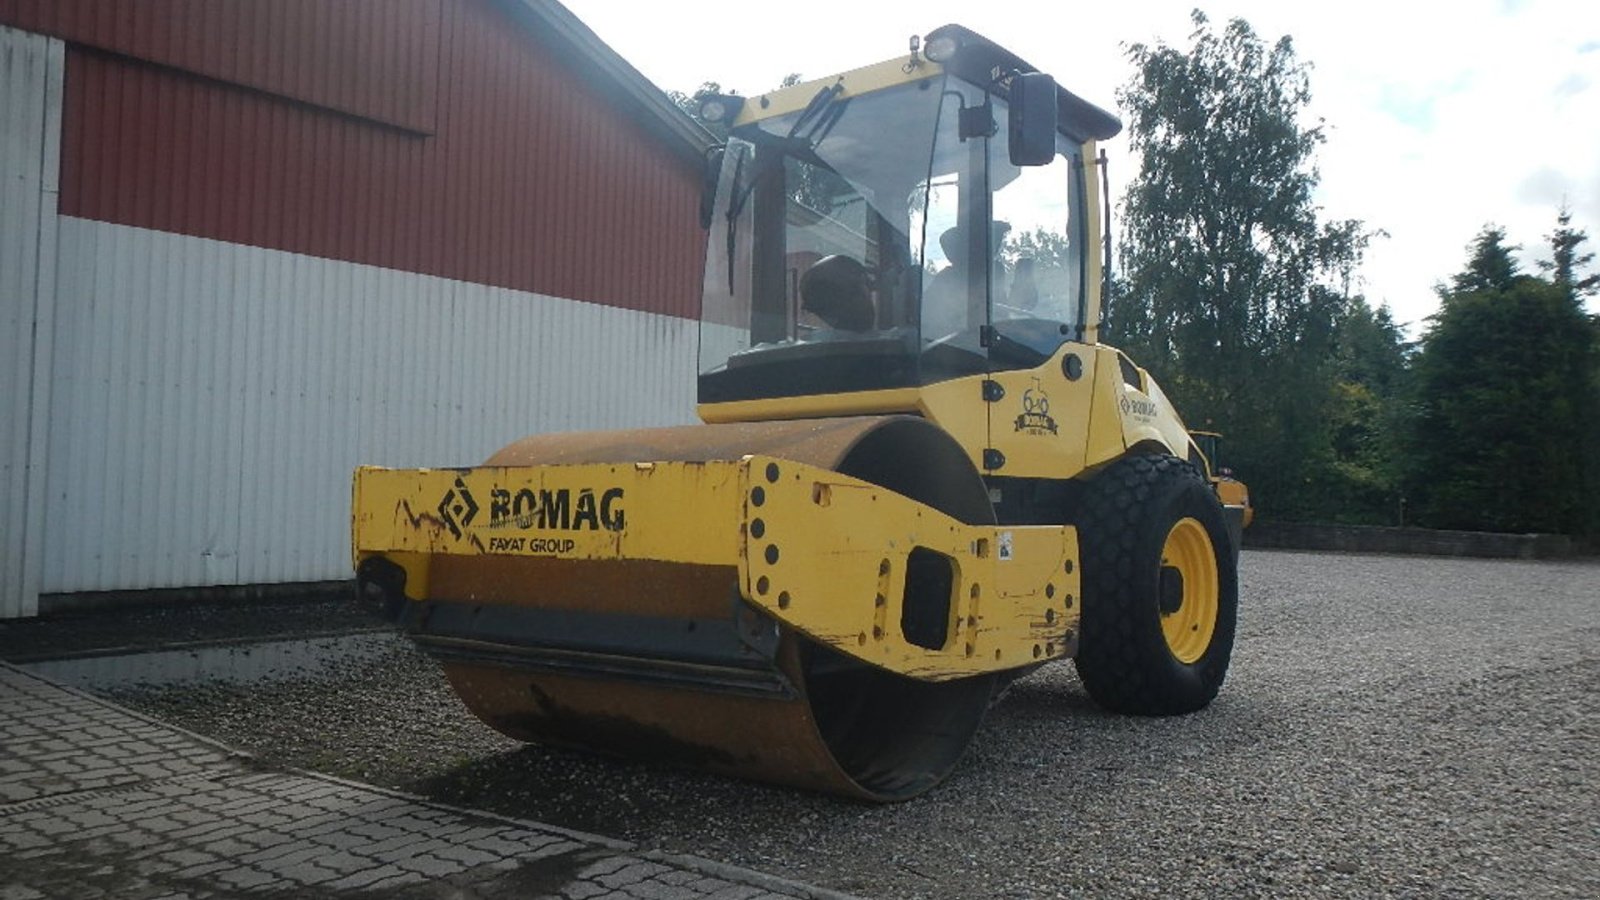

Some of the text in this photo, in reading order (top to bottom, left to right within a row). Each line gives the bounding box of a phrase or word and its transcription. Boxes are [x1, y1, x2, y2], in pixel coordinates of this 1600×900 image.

[490, 487, 625, 532] BOMAG
[490, 537, 575, 553] FAYAT GROUP
